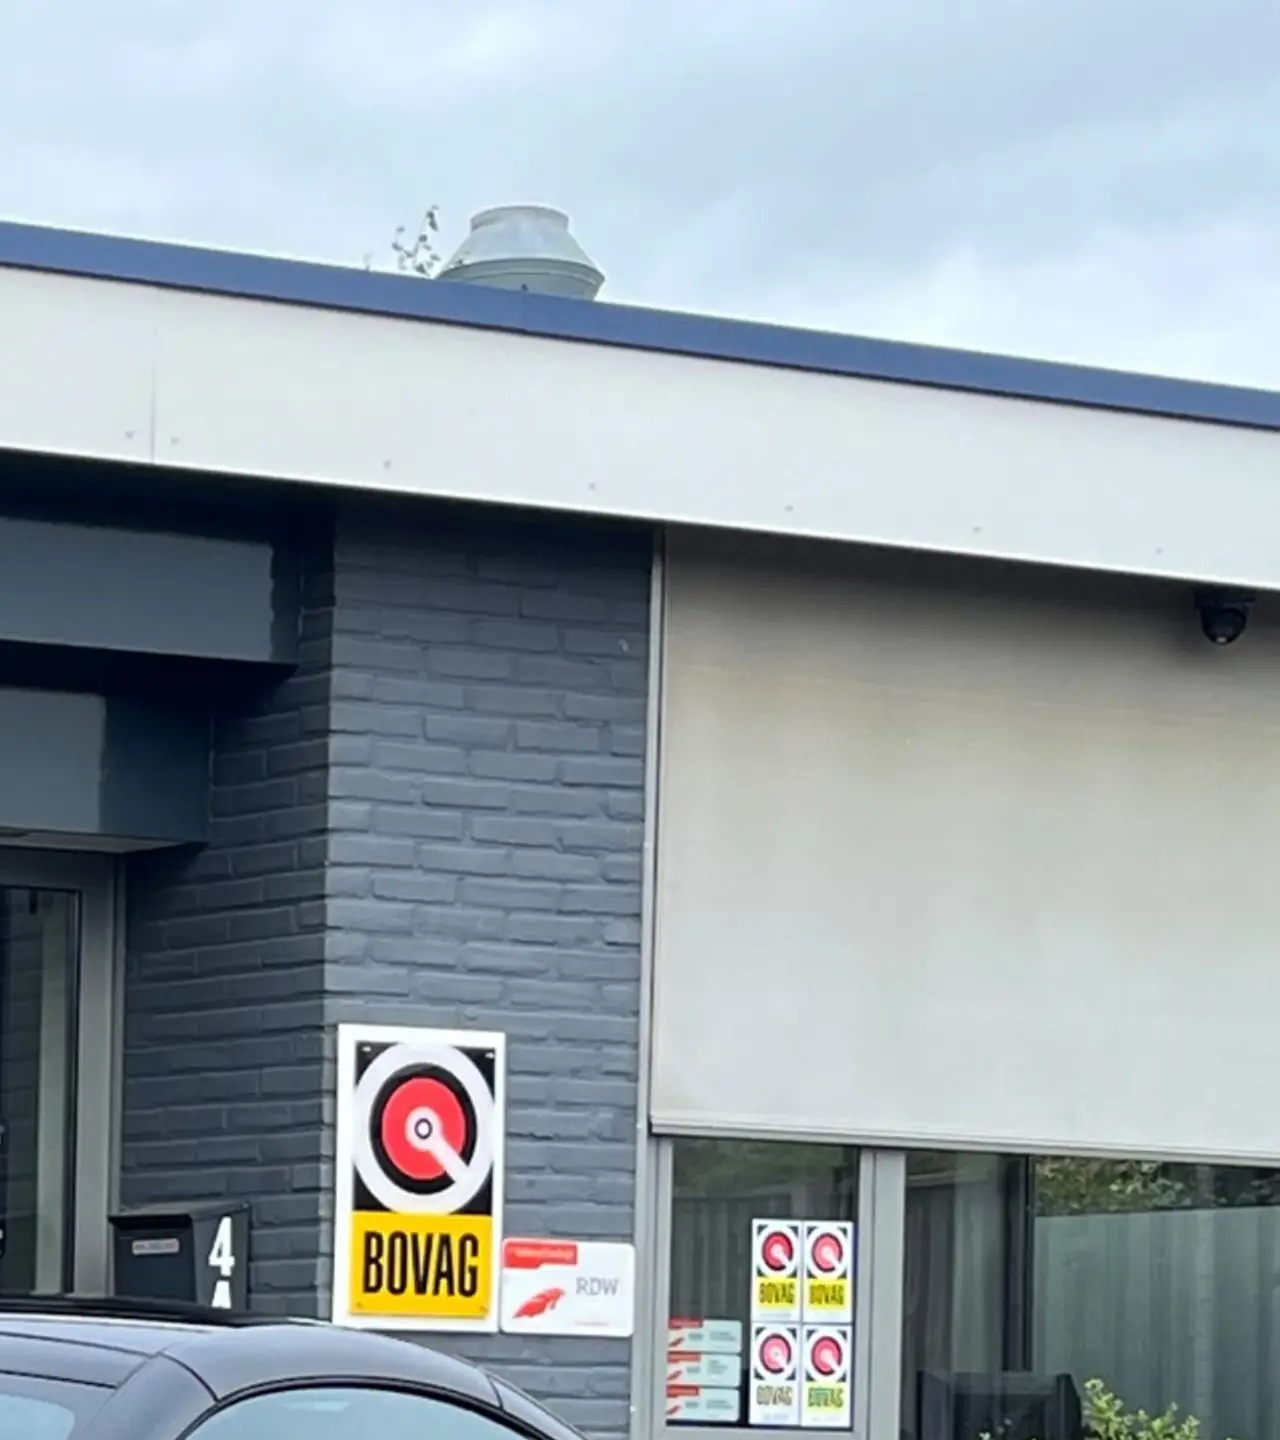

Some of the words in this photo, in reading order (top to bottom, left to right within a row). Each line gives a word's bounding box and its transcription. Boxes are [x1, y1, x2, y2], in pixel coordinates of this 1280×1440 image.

[208, 1216, 235, 1276] 4
[363, 1230, 479, 1297] BOVAG
[576, 1277, 620, 1296] RDW
[759, 1282, 795, 1304] BOVAG
[809, 1284, 845, 1305] BOVAG
[756, 1386, 793, 1406] BOVAG
[808, 1387, 844, 1409] BOVAG
